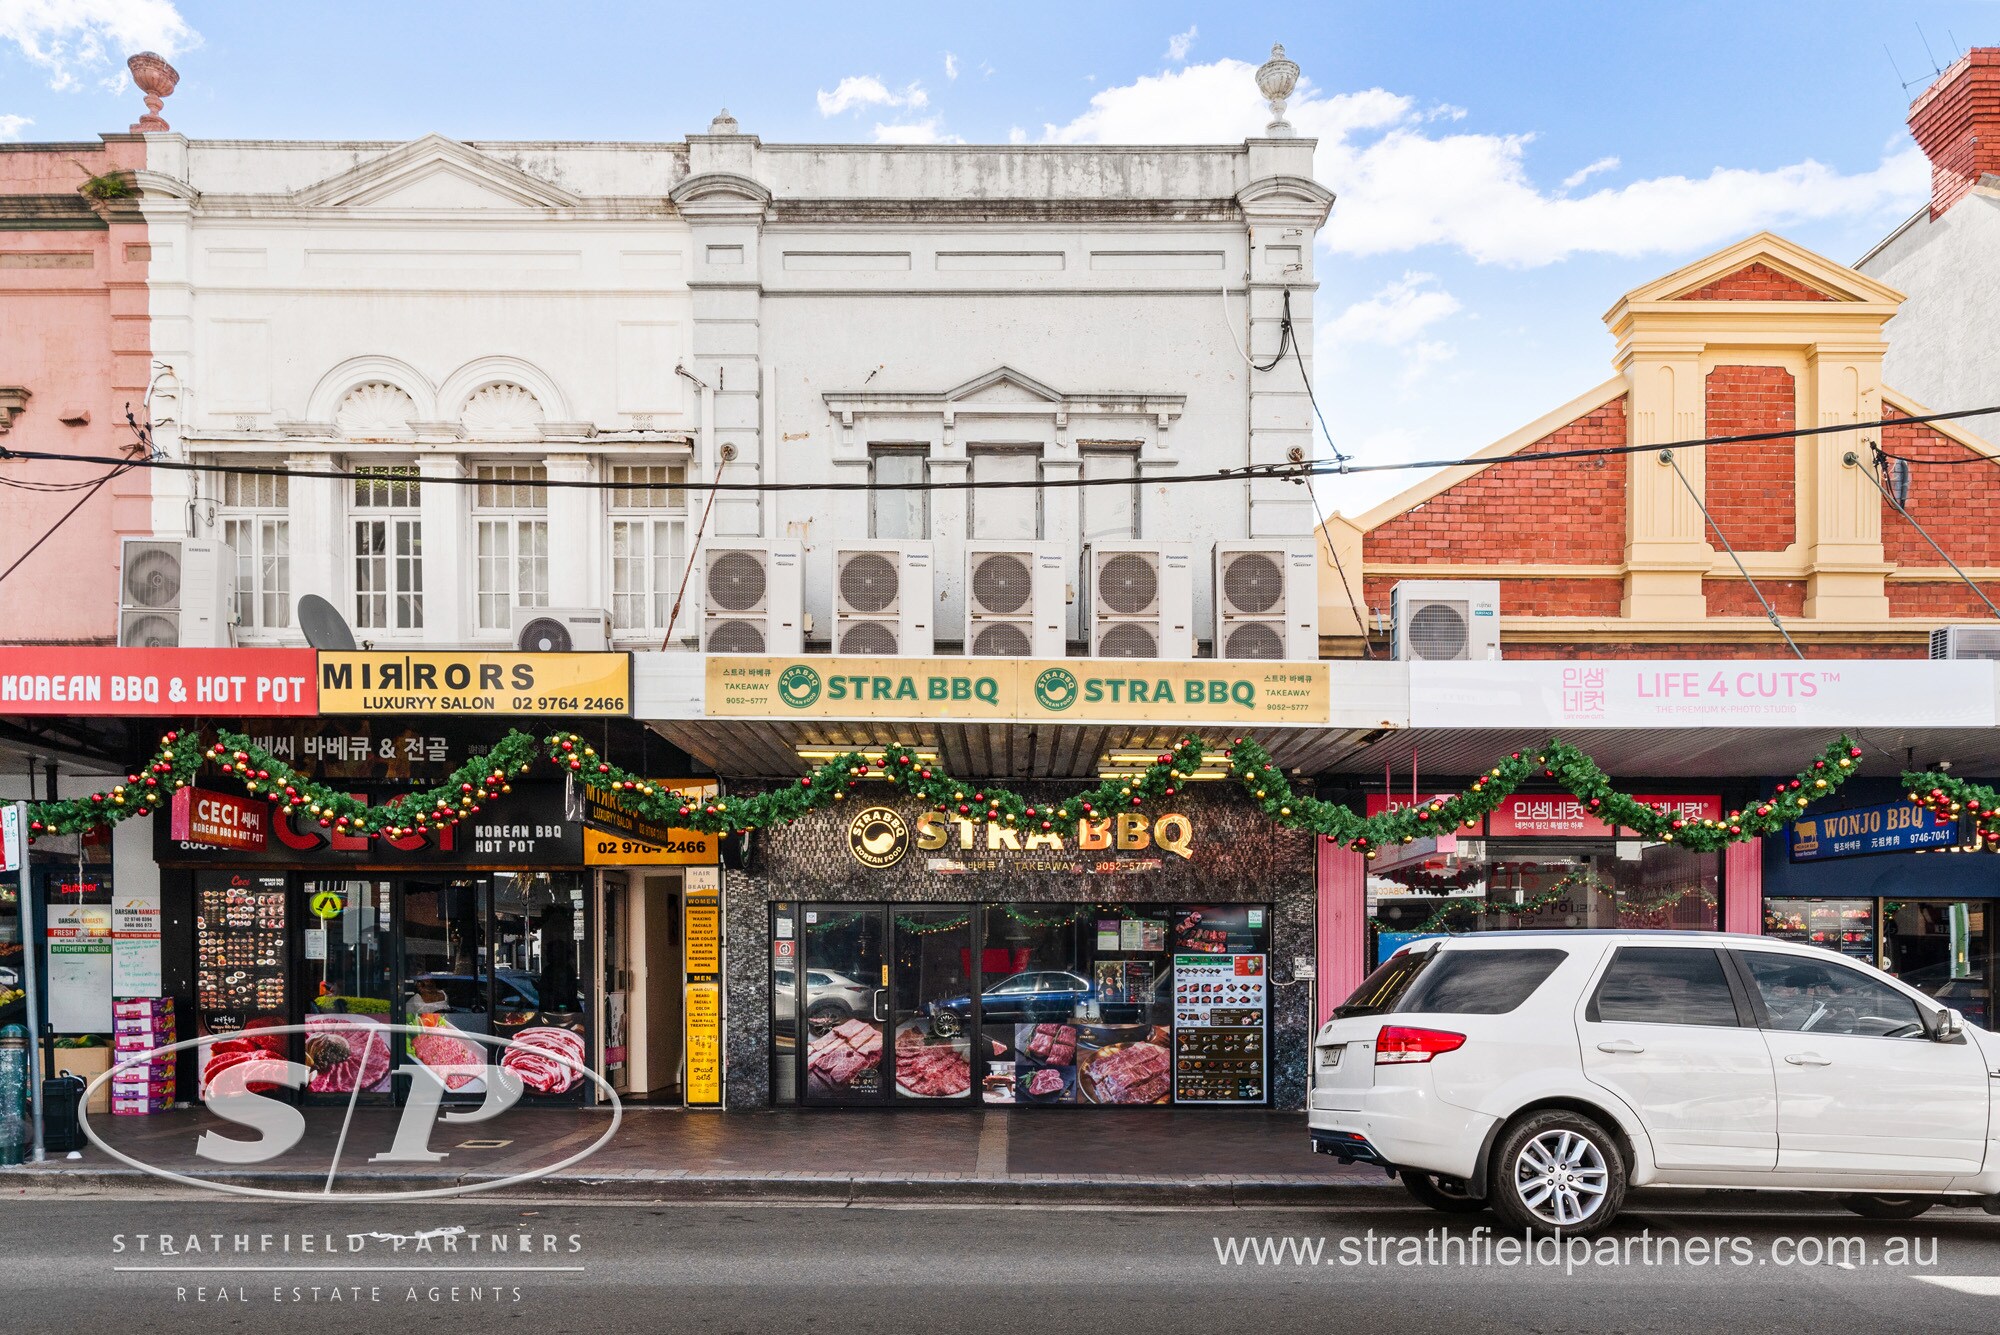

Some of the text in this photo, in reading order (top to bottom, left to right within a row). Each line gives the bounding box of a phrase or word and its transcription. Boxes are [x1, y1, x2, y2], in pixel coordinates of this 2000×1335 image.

[722, 668, 771, 677] 스트라 바베큐
[782, 669, 818, 687] STRA BBQ
[1038, 671, 1075, 689] STRA BBQ
[1263, 674, 1312, 683] 스트라 바베큐
[1562, 667, 1605, 689] 인생
[2, 675, 306, 703] KOREAN BBQ & HOT POT
[828, 675, 1000, 707] STRA BBQ
[1637, 672, 1700, 698] LIFE
[1707, 671, 1728, 698] 4
[726, 697, 768, 705] 9052-5777
[1084, 678, 1257, 709] STRA BBQ
[1265, 689, 1311, 697] TAKEAWAY
[1562, 690, 1605, 712] 네컷
[363, 697, 624, 710] LUXURYY SALON 02 9764 2466
[1266, 703, 1309, 711] 9052-5777
[1655, 705, 1797, 714] THE PREMIUM K-PHOTO STUDIO
[303, 736, 371, 761] 바베큐
[378, 737, 396, 759] &
[404, 736, 449, 762] 전골
[198, 800, 238, 826] CECI
[1513, 801, 1585, 820] 인생네컷
[853, 811, 905, 838] STRA BBQ
[1514, 822, 1584, 830] 네컷에 담긴 특별한 하루
[1824, 806, 1925, 839] WONJO BBQ
[193, 823, 263, 843] KOREAN BBQ & HOT POT
[475, 825, 562, 838] KOREAN BBQ
[1079, 813, 1194, 859] BBQ
[1910, 829, 1950, 844] 9746-7041
[475, 840, 536, 852] HOT POT
[597, 842, 617, 854] 02
[666, 841, 706, 853] 2466
[855, 845, 902, 863] KOREAN FOOD
[935, 861, 996, 871] 스트라 바베큐
[1014, 861, 1076, 871] TAKEAWAY
[1095, 861, 1154, 871] 9052-5777
[53, 945, 87, 953] BUTCHERY
[88, 945, 110, 953] INSIDE
